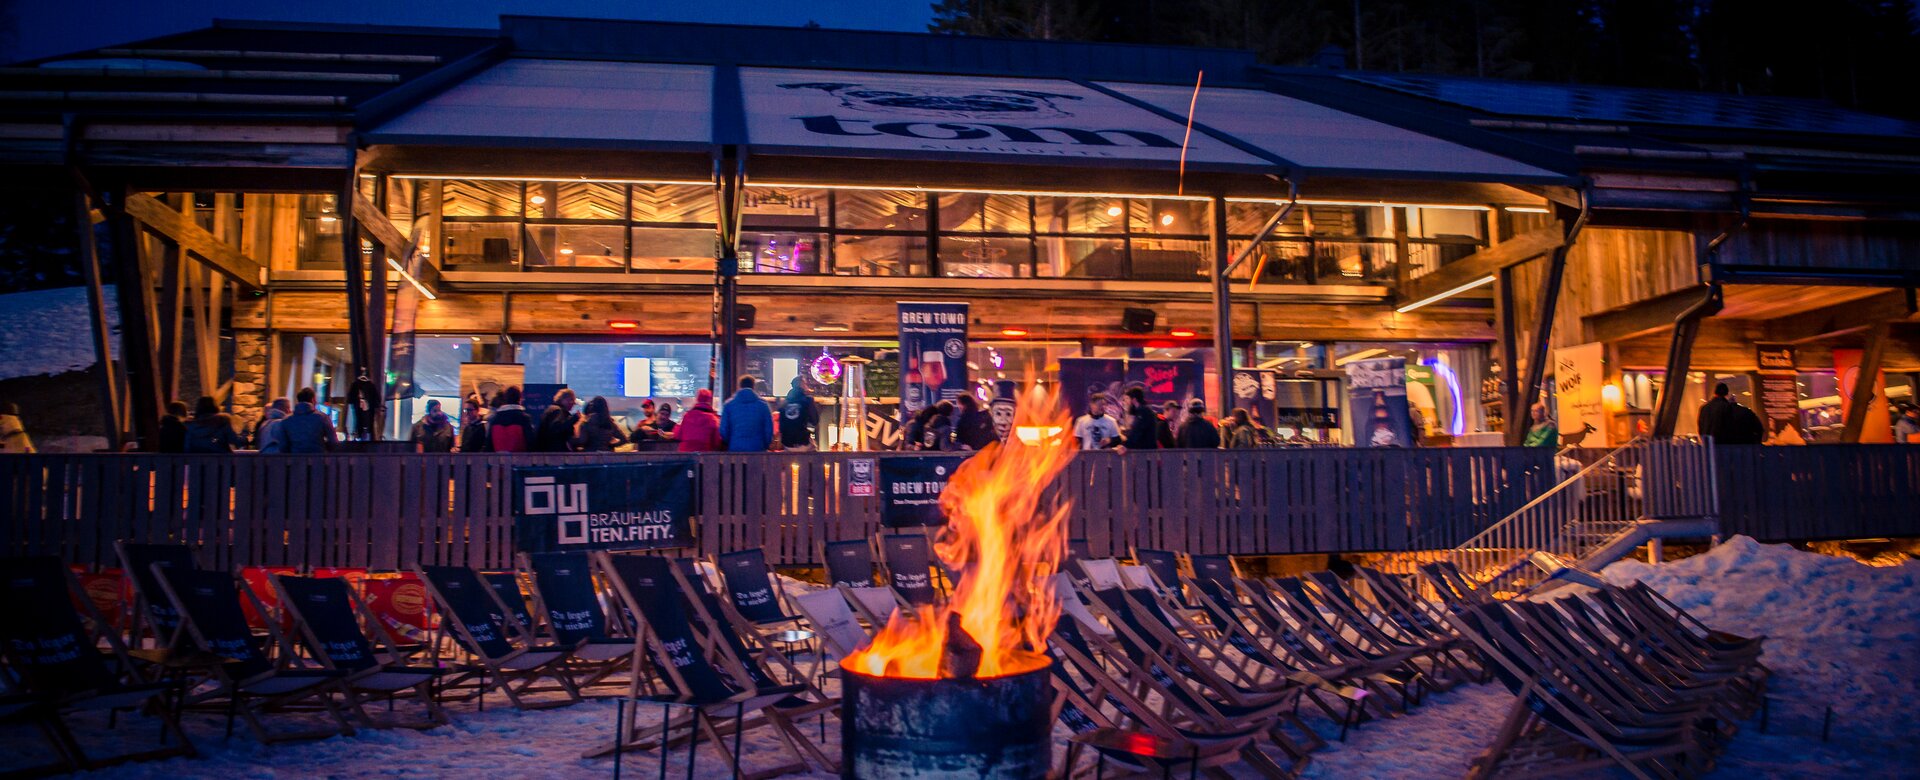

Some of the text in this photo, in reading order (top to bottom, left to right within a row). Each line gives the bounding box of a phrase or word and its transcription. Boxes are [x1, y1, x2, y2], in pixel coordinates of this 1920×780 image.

[790, 115, 1196, 149] tom
[902, 312, 966, 324] BREW TOWN
[892, 482, 923, 494] BREW
[590, 510, 672, 527] BRÄUHAUS
[591, 525, 674, 543] TEN.FIFTY.
